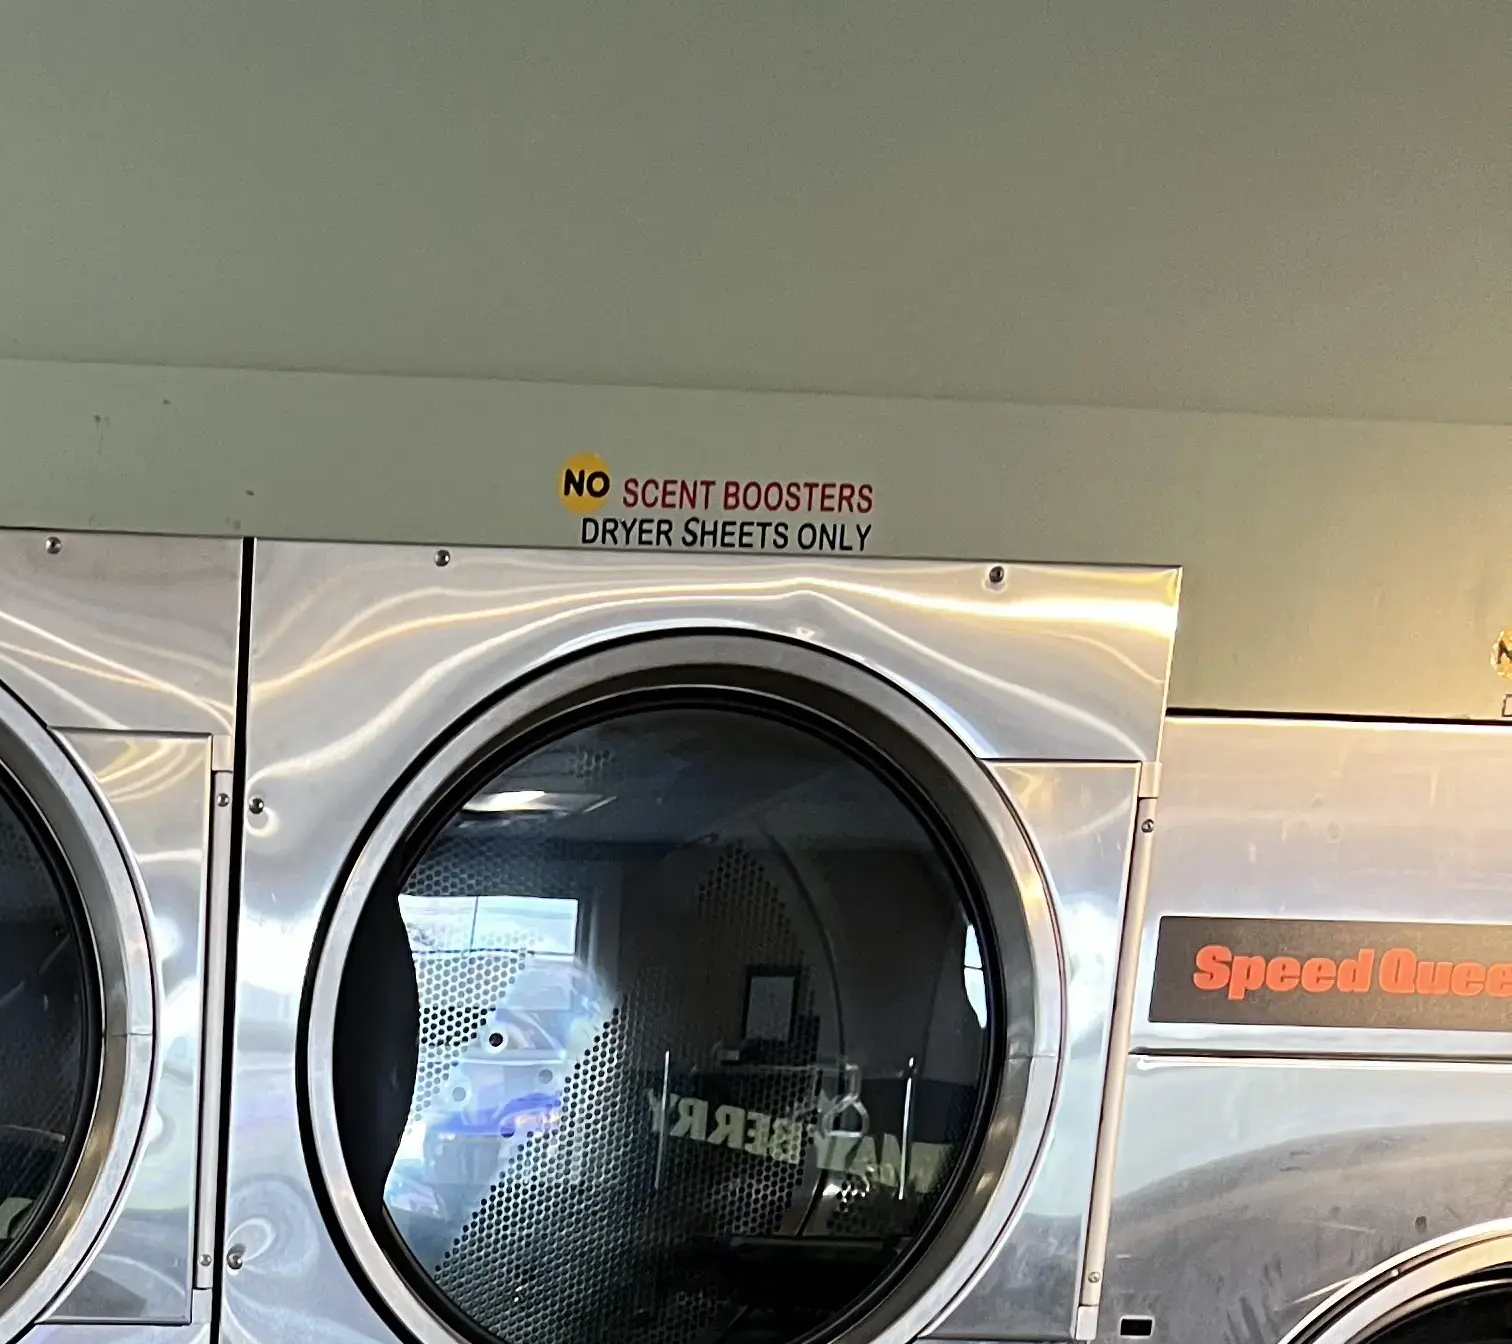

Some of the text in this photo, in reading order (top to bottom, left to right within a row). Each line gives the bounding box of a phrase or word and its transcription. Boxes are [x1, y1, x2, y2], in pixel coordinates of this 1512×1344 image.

[564, 468, 873, 514] NO SCENT BOOSTERS
[581, 516, 872, 552] DRYER SHEETS ONLY
[1193, 945, 1512, 1000] Speed Quee
